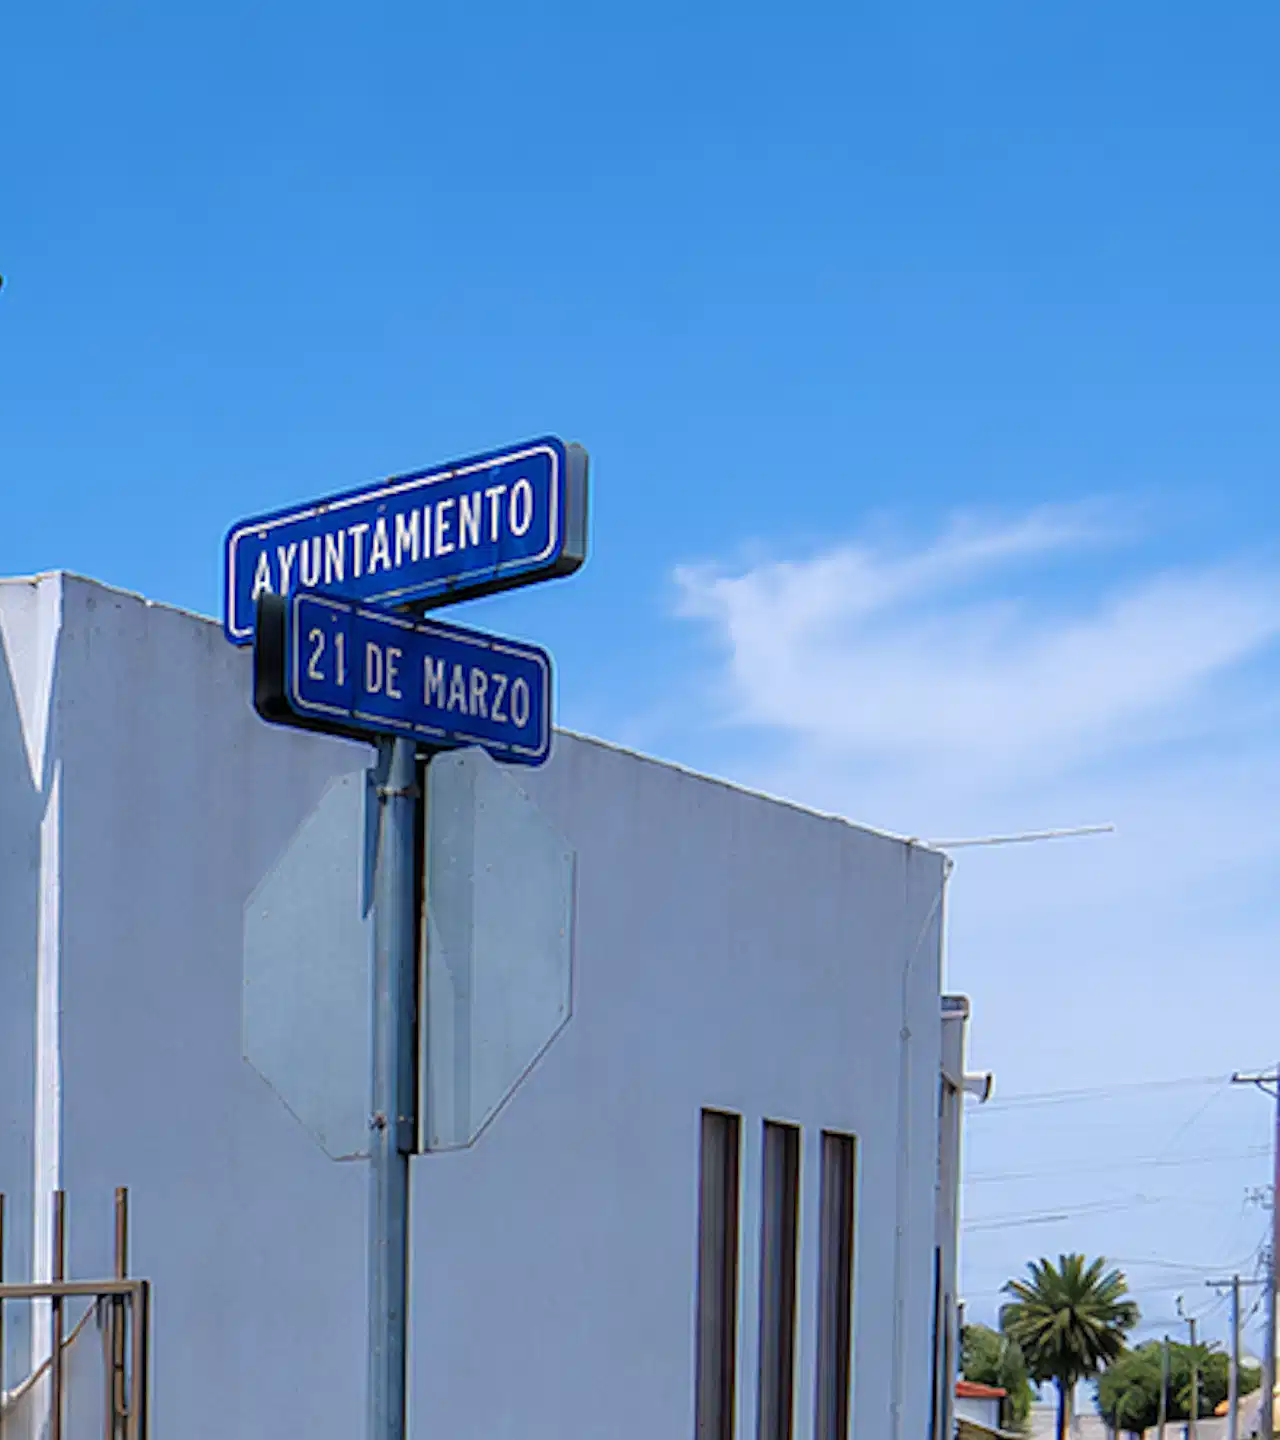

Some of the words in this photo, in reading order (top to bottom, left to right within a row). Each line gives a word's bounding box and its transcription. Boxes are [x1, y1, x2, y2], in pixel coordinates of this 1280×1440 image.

[251, 477, 535, 601] AYUNTAMIENTO
[307, 627, 346, 687] 21
[365, 641, 403, 700] DE
[422, 655, 531, 729] MARZO
